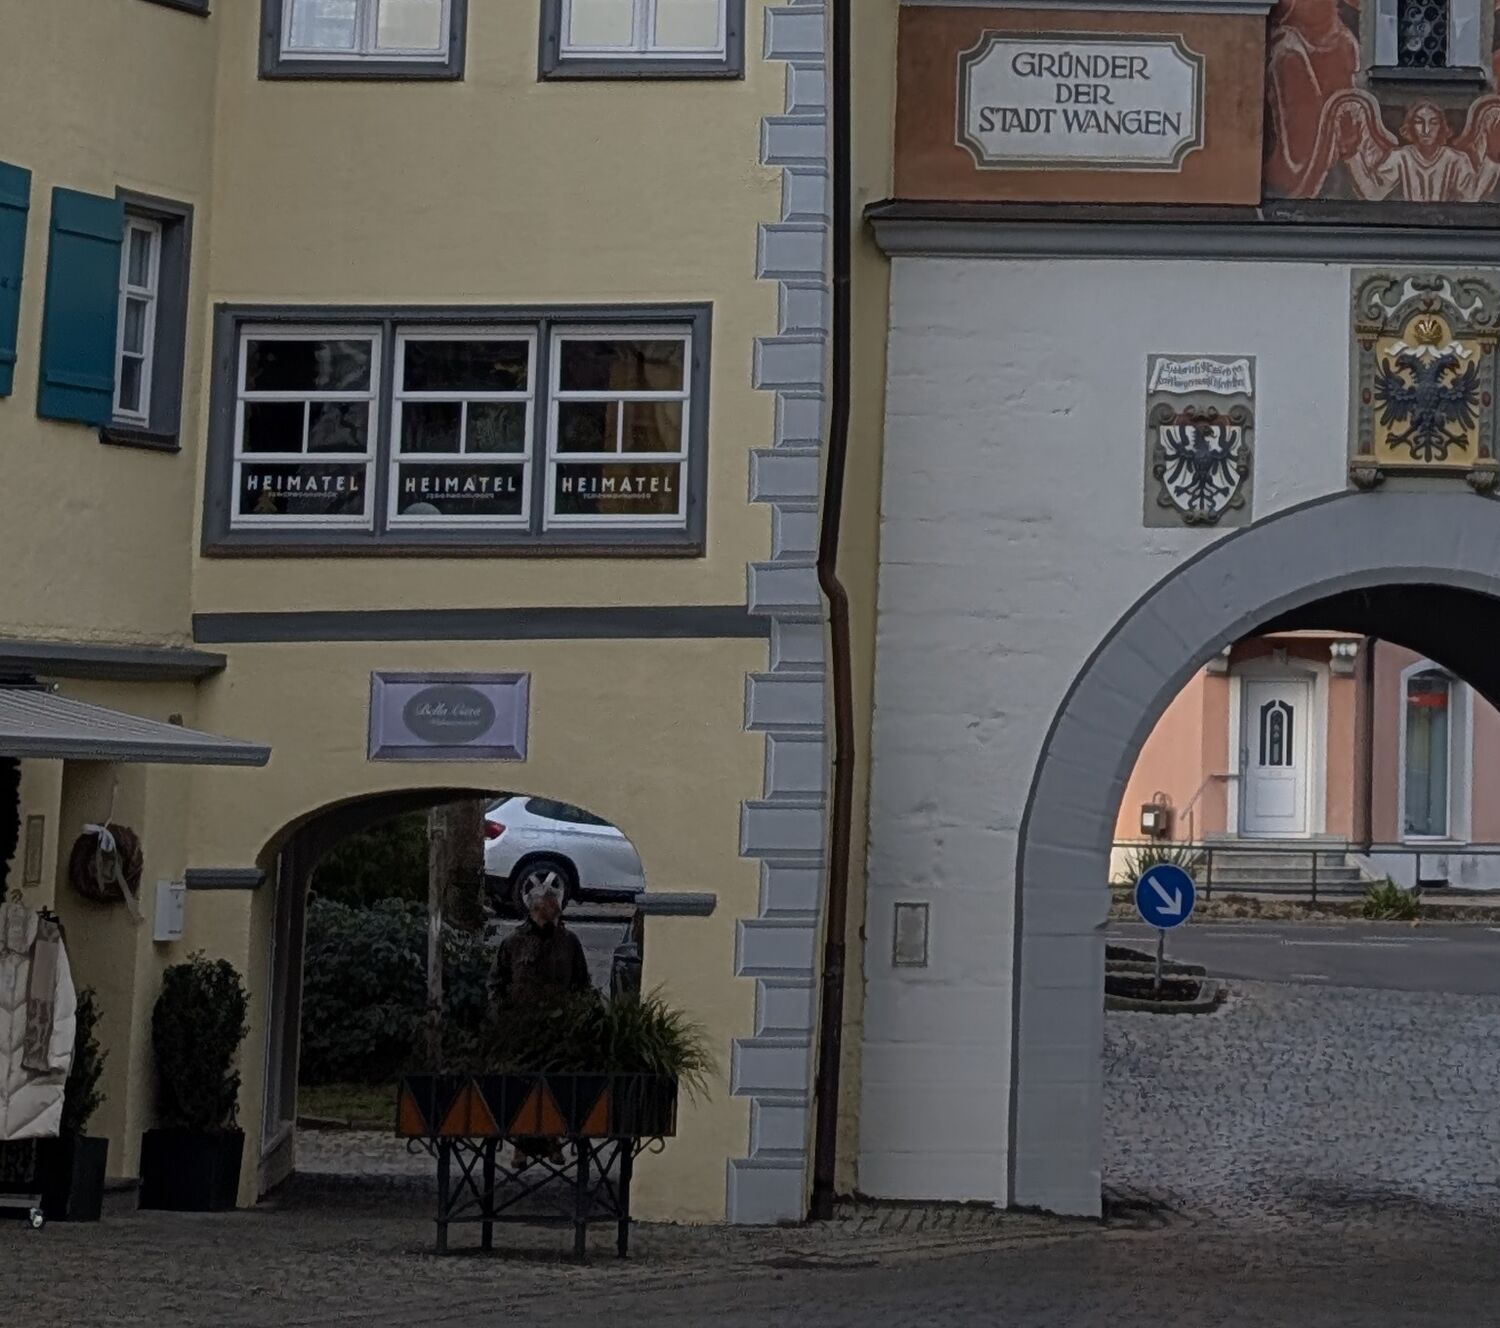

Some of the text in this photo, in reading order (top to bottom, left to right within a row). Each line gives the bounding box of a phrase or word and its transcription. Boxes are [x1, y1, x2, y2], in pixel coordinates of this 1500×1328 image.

[1011, 51, 1150, 80] GRÜNDER
[1055, 83, 1114, 105] DER
[979, 106, 1182, 136] STADT WANGEN
[246, 474, 360, 491] HEIMATEL
[405, 476, 516, 493] HEIMATEL
[561, 476, 673, 493] HEIMATEL
